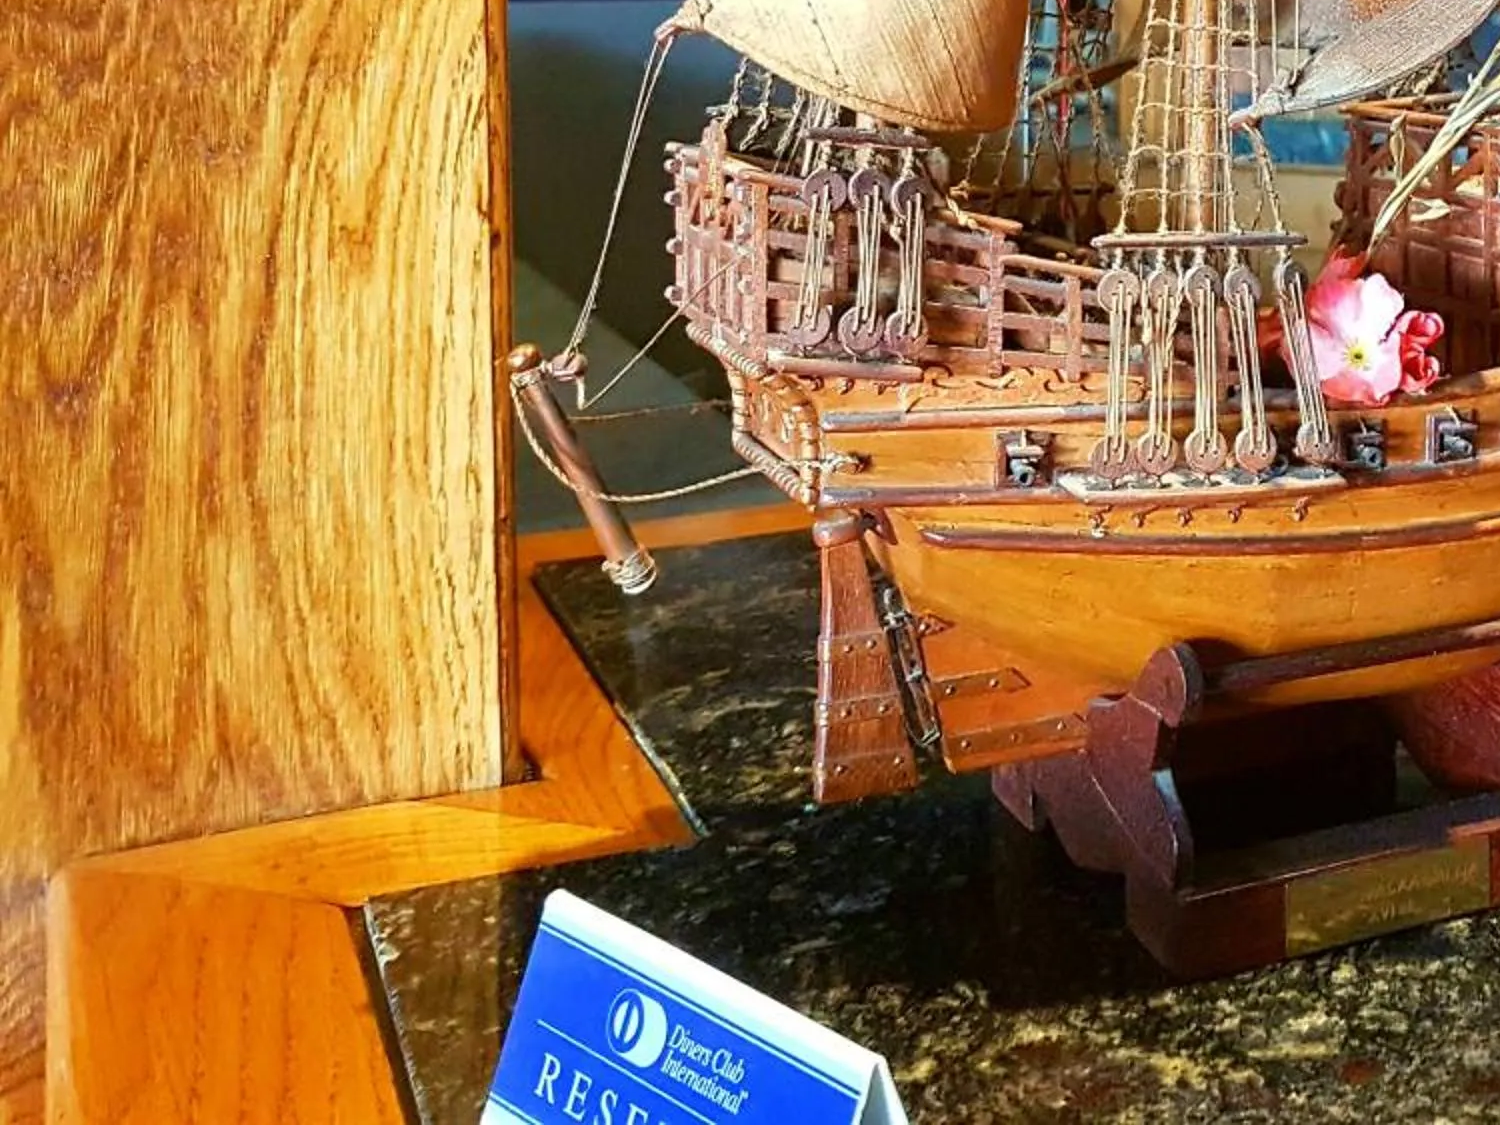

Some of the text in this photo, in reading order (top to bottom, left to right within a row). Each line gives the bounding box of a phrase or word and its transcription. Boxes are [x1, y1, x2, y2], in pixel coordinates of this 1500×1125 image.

[660, 1049, 742, 1115] International
[668, 1024, 745, 1084] Diners Club
